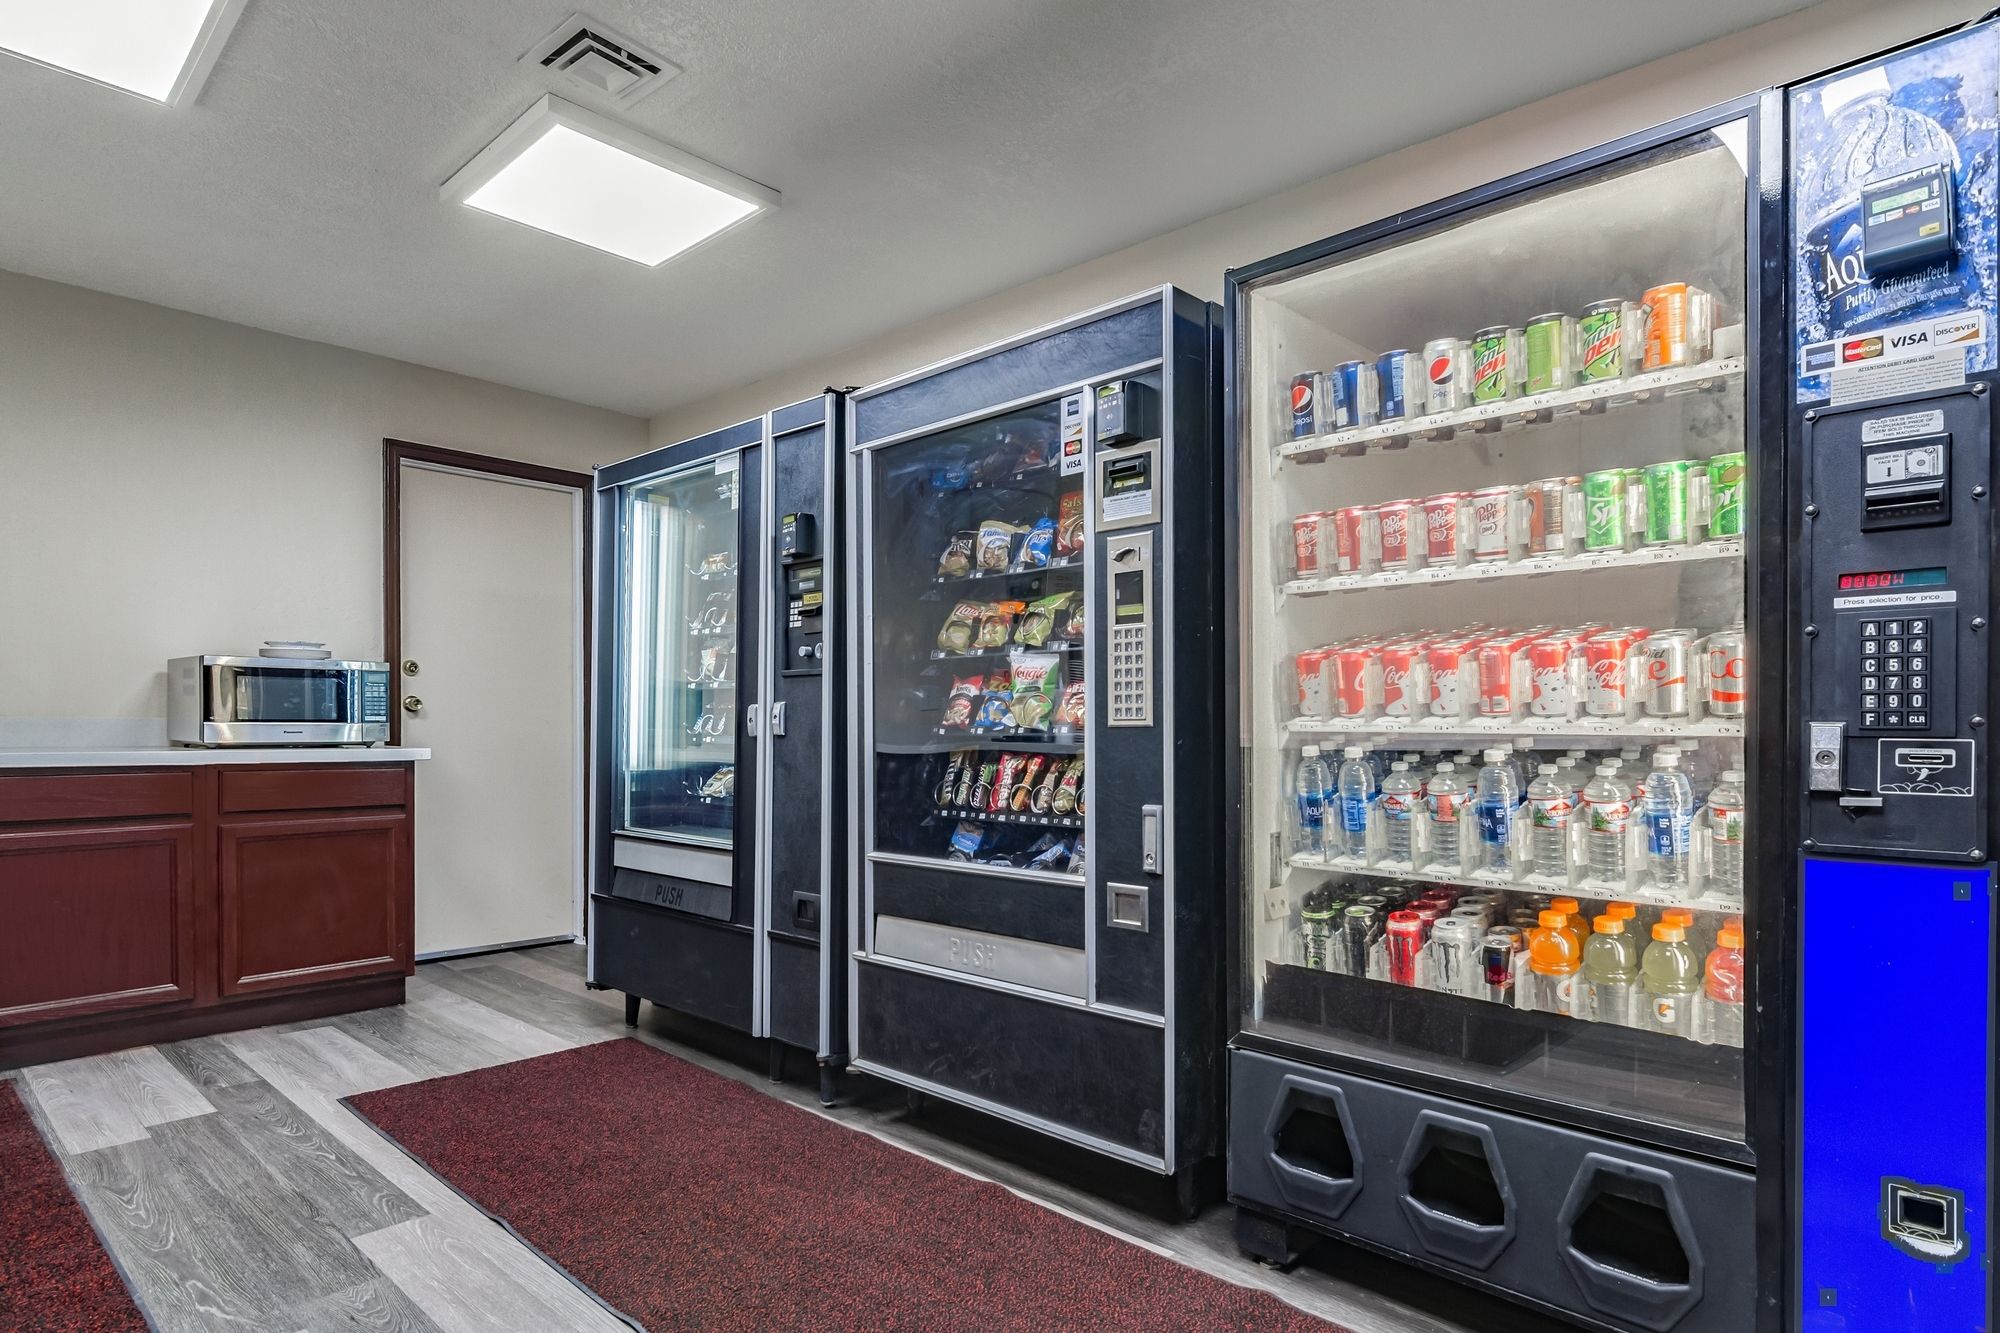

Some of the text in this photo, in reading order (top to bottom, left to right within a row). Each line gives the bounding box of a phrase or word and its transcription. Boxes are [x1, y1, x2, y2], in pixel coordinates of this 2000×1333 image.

[1846, 261, 1949, 310] Purity Guaranteed
[1936, 322, 1977, 336] DISCOVER
[1890, 332, 1928, 350] VISA
[1845, 344, 1882, 356] MasterCard
[1858, 364, 1887, 372] ATTENTION
[1066, 459, 1081, 469] VISA
[1868, 596, 1902, 604] selection
[1865, 621, 1922, 636] A 1 2
[1865, 640, 1922, 653] B 3 4
[1865, 658, 1922, 672] C 5 6
[1865, 677, 1922, 689] D 7 8
[1866, 695, 1921, 707] E 9 0
[1866, 714, 1925, 725] F CLR
[655, 884, 684, 907] PUSH
[950, 937, 998, 971] PUSH
